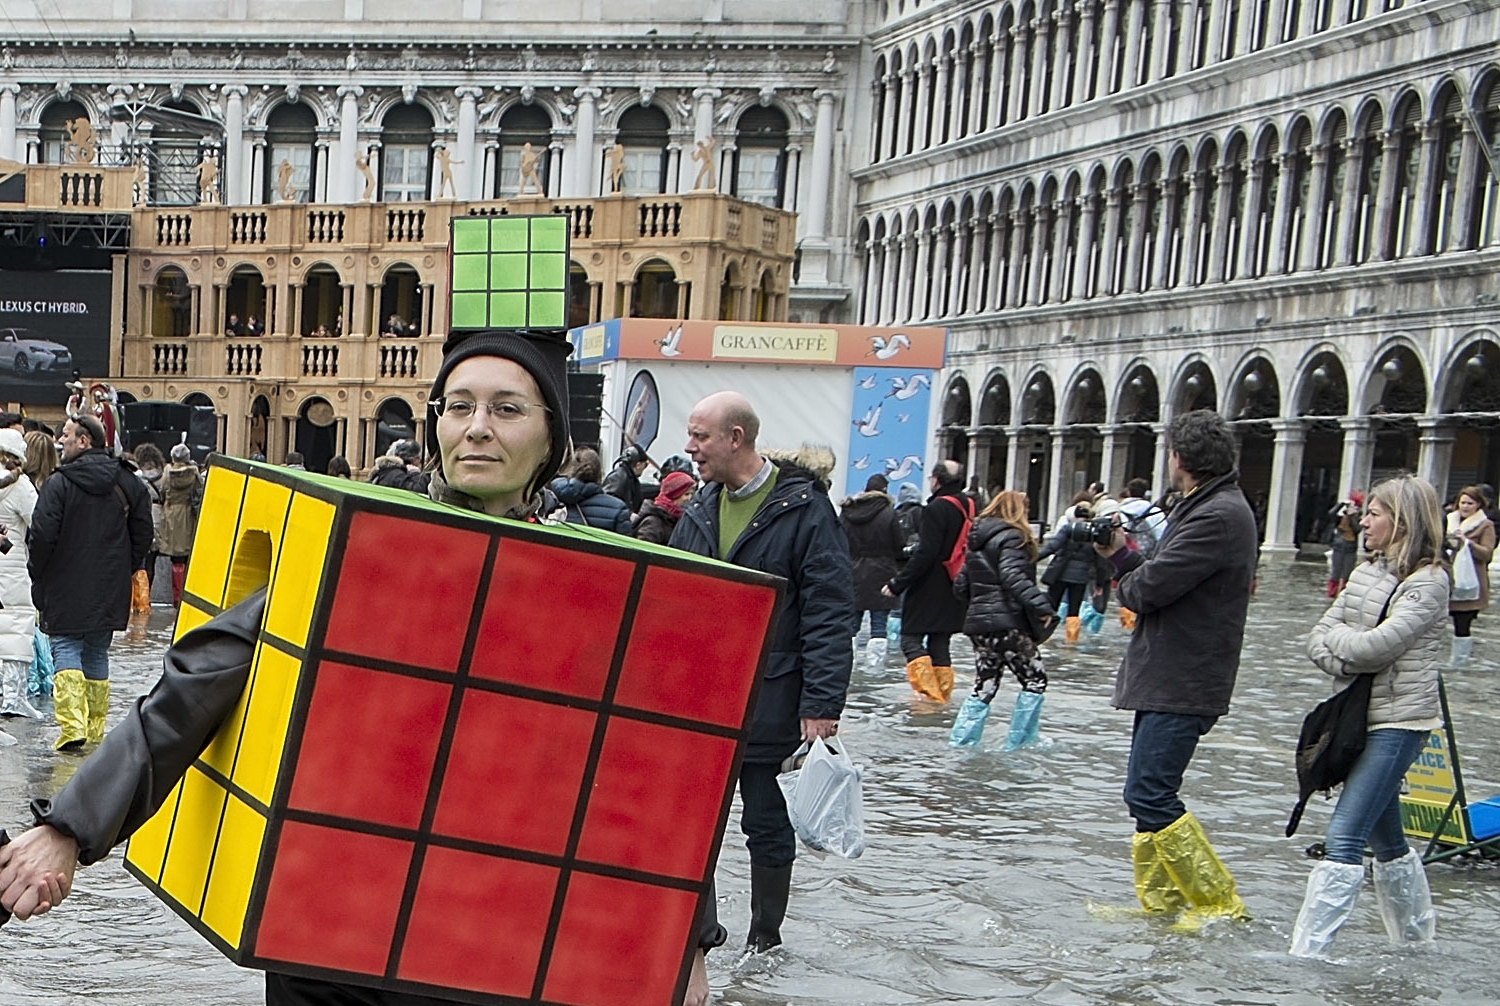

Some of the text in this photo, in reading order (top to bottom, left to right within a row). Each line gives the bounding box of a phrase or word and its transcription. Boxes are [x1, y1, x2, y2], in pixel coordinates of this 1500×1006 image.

[1, 300, 32, 313] LEXUS
[34, 301, 47, 313] CT
[49, 301, 89, 314] HYBRID.
[721, 334, 828, 352] GRANCAFFÈ
